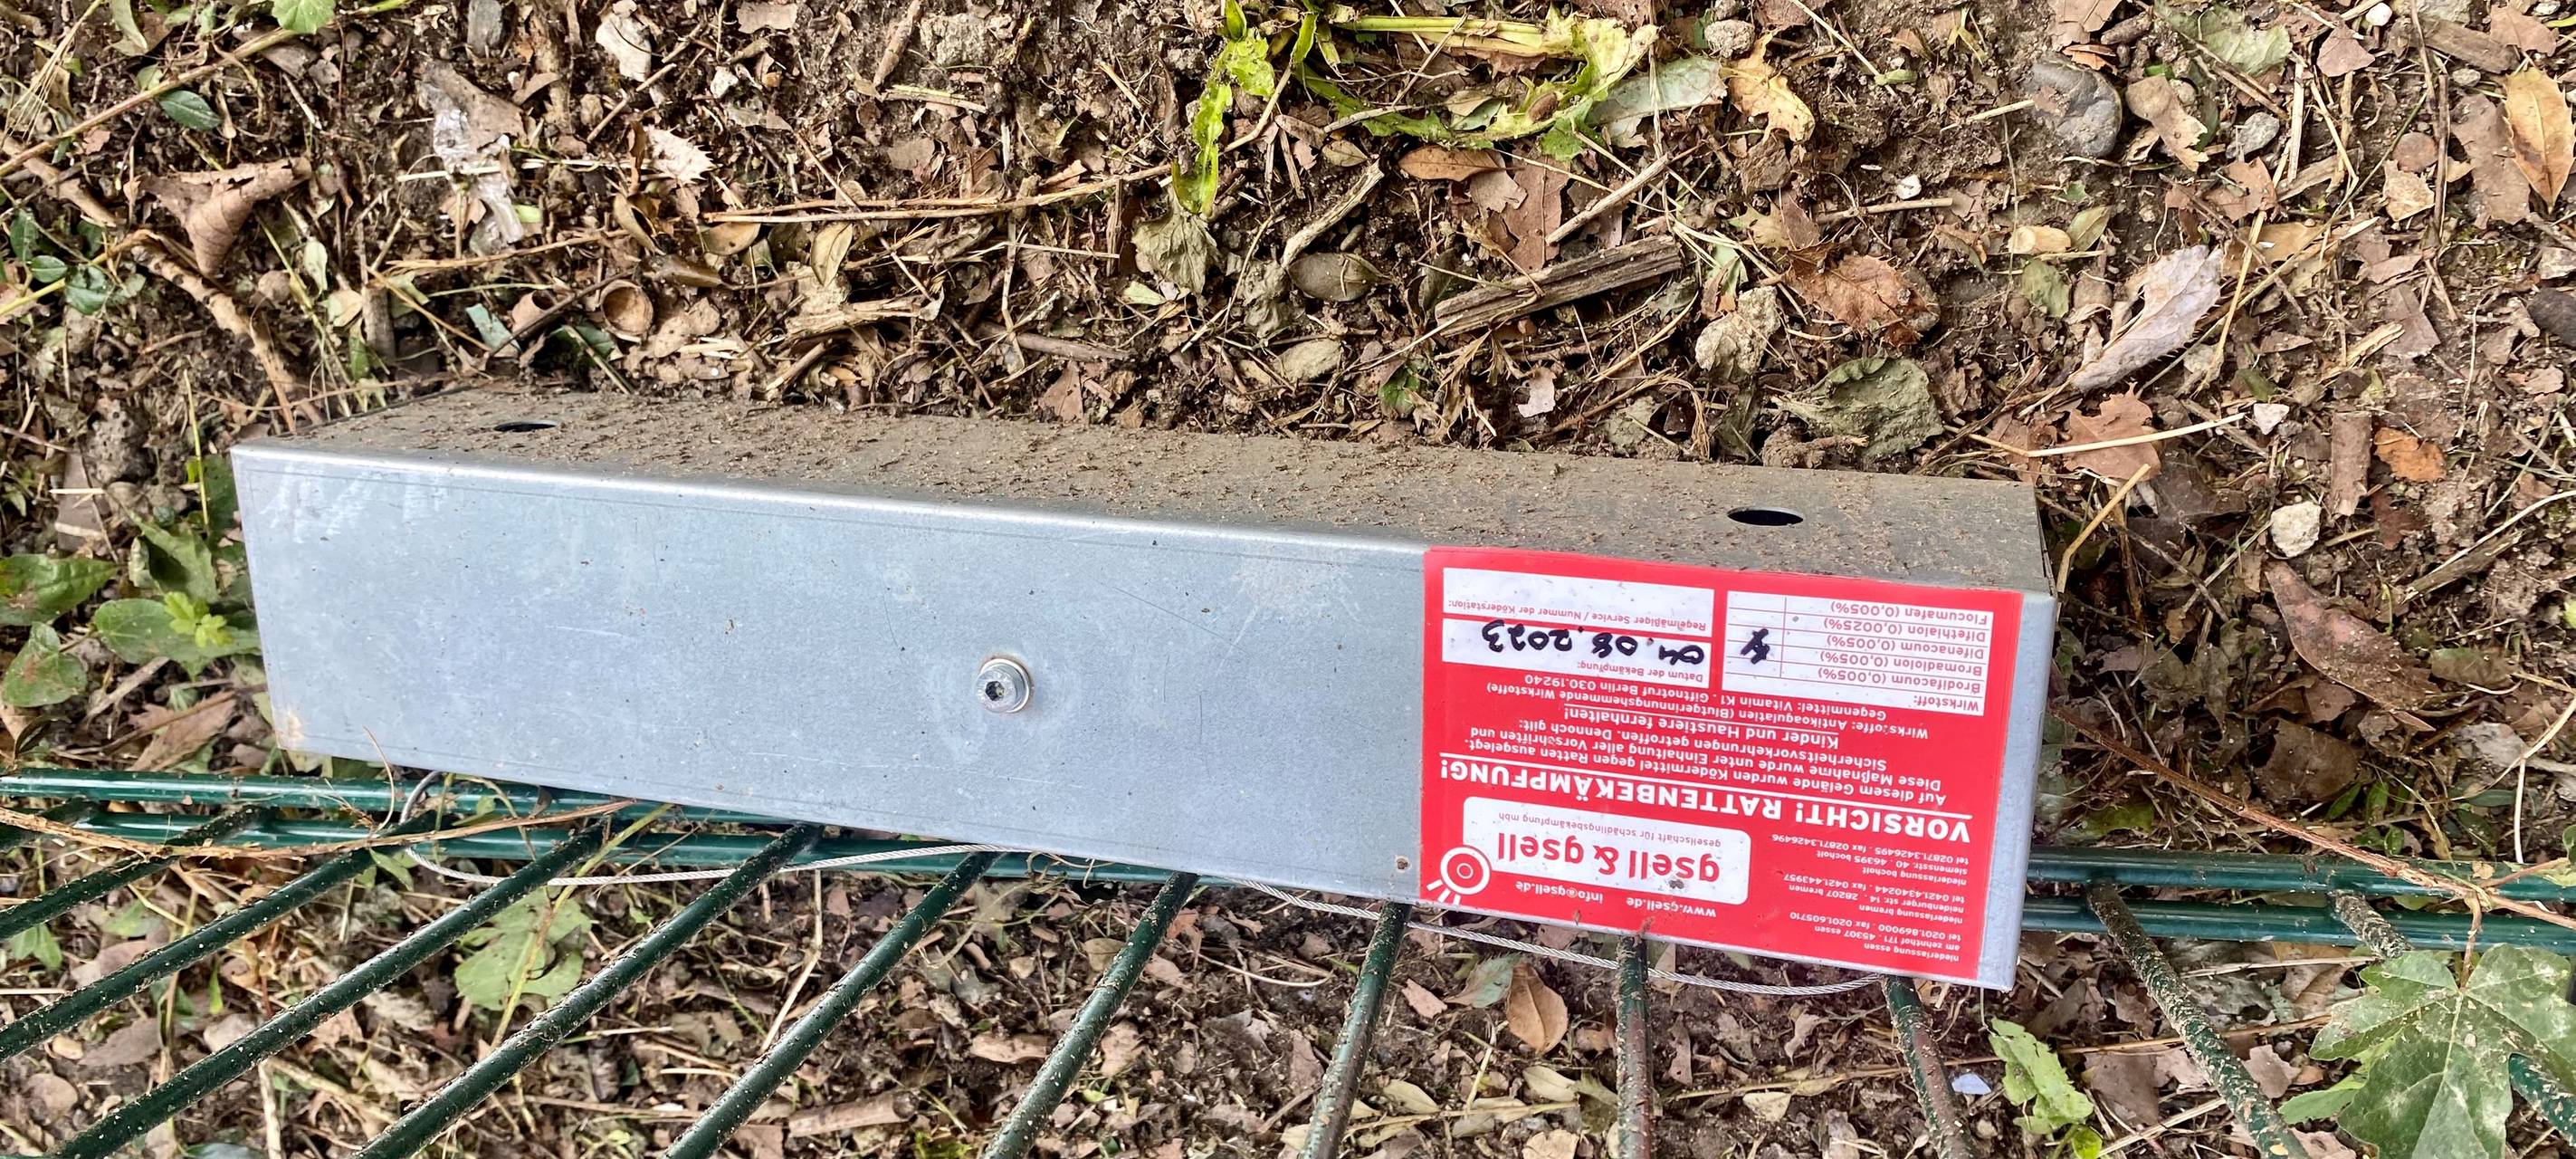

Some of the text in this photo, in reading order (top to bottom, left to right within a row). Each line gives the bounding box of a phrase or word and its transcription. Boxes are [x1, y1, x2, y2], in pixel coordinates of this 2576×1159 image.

[1447, 599, 1515, 614] Köderstation:
[1517, 606, 1535, 616] der
[1537, 608, 1581, 620] Nummer
[1829, 600, 1988, 626] Flocumafen (0,005%)
[1590, 612, 1630, 625] Service
[1633, 616, 1706, 632] Regelmäßiger
[1822, 617, 1986, 642] Difethialon (0,0025%)
[1826, 634, 1984, 659] Difenacoum (0,005%)
[1819, 649, 1982, 676] Bromadiolon (0,005%)
[1577, 659, 1703, 683] Datum der Bekämpfung:
[1523, 674, 1597, 691] 030.19240
[1598, 681, 1637, 695] Berlin
[1817, 666, 1980, 694] Brodifacoum (0,005%)
[1485, 682, 1555, 700] Wirkstoffe)
[1641, 685, 1709, 704] Giftnotruf
[1558, 690, 1734, 719] (Blutgerinnungshemmende
[1720, 694, 1735, 706] K1
[1739, 696, 1793, 712] Vitamin
[1913, 694, 1979, 712] Wirkstoff:
[1797, 702, 1886, 721] Gegenmittel:
[1563, 707, 1838, 750] Kinder und Haustiere fernhalten!
[1518, 718, 1886, 770] Sicherheitsvorkehrungen getroffen. Dennoch gilt:
[1470, 726, 1942, 791] Diese Maßnahme wurde unter Einhaltung aller Vorschriften und
[1464, 737, 1946, 806] Auf diesem Gelände wurden Ködermittel gegen Ratten ausgelegt.
[1440, 758, 1970, 843] VORSICHT! RATTENBEKÄMPFUNG!
[1498, 811, 1722, 848] gesellschaft für schädlingsbekämpfung mbh
[1771, 833, 1849, 851] 02871.3426496
[1851, 843, 1866, 853] fax
[1497, 831, 1720, 886] gsell & gsell
[1816, 849, 1852, 862] bocholt
[1853, 854, 1888, 866] 46395
[1874, 847, 1953, 864] 02871.3426495
[1894, 859, 1910, 868] 40
[1955, 856, 1970, 866] tel
[1861, 866, 1967, 886] niederlassung bocholt
[1912, 861, 1968, 876] siemensstr.
[1782, 873, 1849, 889] 0421.443957
[1851, 882, 1866, 891] fax
[1515, 881, 1603, 904] info@gsell.de
[1788, 884, 1824, 896] bremen
[1825, 889, 1858, 901] 28207
[1874, 885, 1950, 902] 0421.4340244
[1625, 896, 1717, 917] www.gsell.de
[1869, 895, 1880, 904] 14
[1883, 896, 1899, 905] str.
[1900, 898, 1964, 914] neidenburger
[1951, 895, 1965, 904] tel
[1789, 911, 1853, 927] 0201.605710
[1857, 904, 1963, 924] niederlassung bremen
[1813, 924, 1841, 934] essen
[1855, 920, 1870, 930] fax
[1877, 923, 1946, 940] 0201.869000
[1843, 929, 1876, 941] 45307
[1883, 934, 1898, 943] 171
[1900, 936, 1942, 949] zehnthof
[1947, 933, 1961, 942] tel
[1863, 942, 1959, 962] niederlassung essen
[1944, 943, 1961, 951] am
